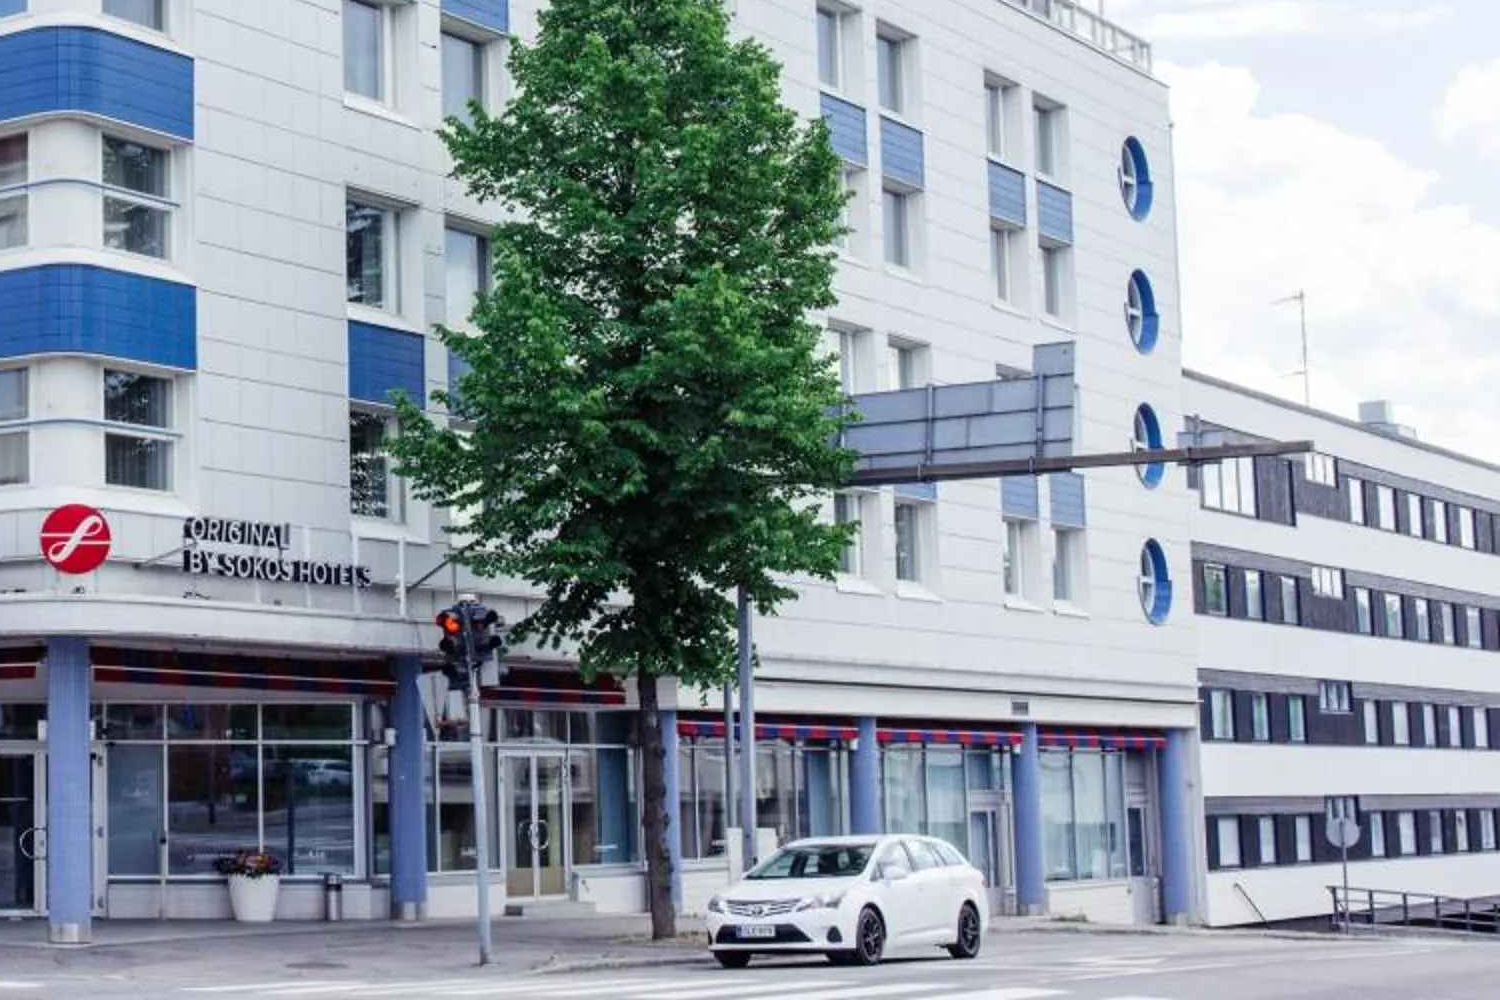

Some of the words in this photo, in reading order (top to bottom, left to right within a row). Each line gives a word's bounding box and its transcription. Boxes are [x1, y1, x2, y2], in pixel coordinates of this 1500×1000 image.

[190, 517, 290, 549] ORIGINAL
[189, 550, 215, 574] BY
[223, 553, 294, 582] SOKOS
[298, 561, 372, 588] HOTELS
